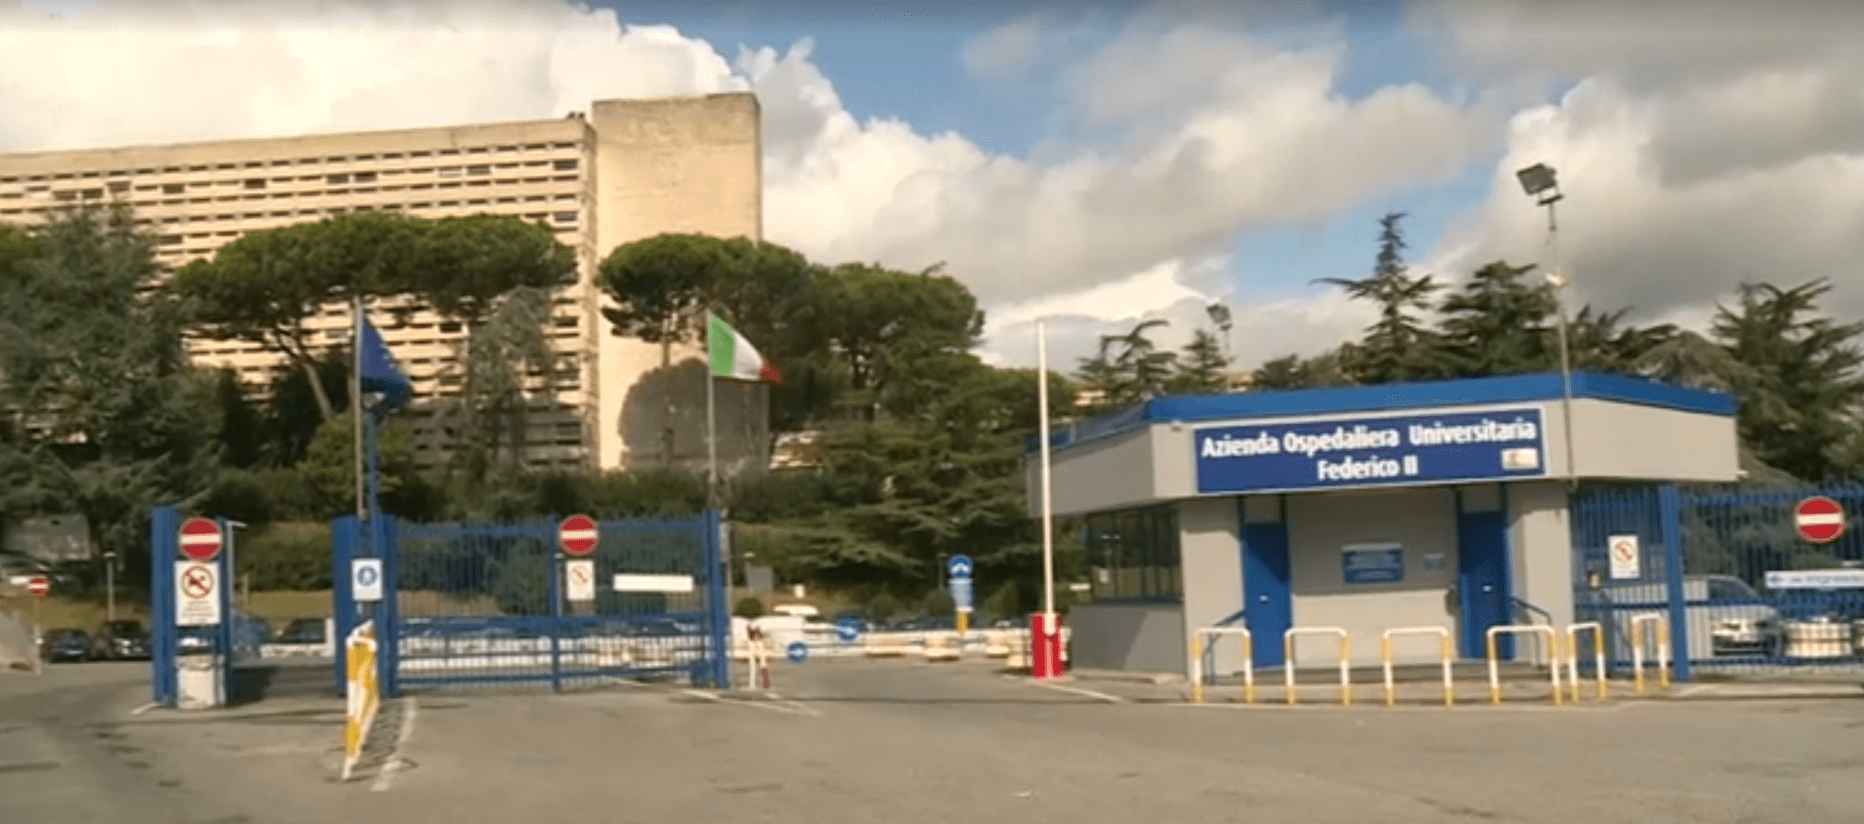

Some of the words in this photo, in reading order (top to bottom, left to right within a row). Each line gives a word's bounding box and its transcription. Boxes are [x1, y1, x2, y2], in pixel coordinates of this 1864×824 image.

[1202, 431, 1279, 458] Azienda
[1283, 425, 1400, 456] Ospedaliera
[1409, 417, 1537, 446] Universitaria
[1317, 455, 1400, 481] Federico
[1403, 455, 1418, 476] II
